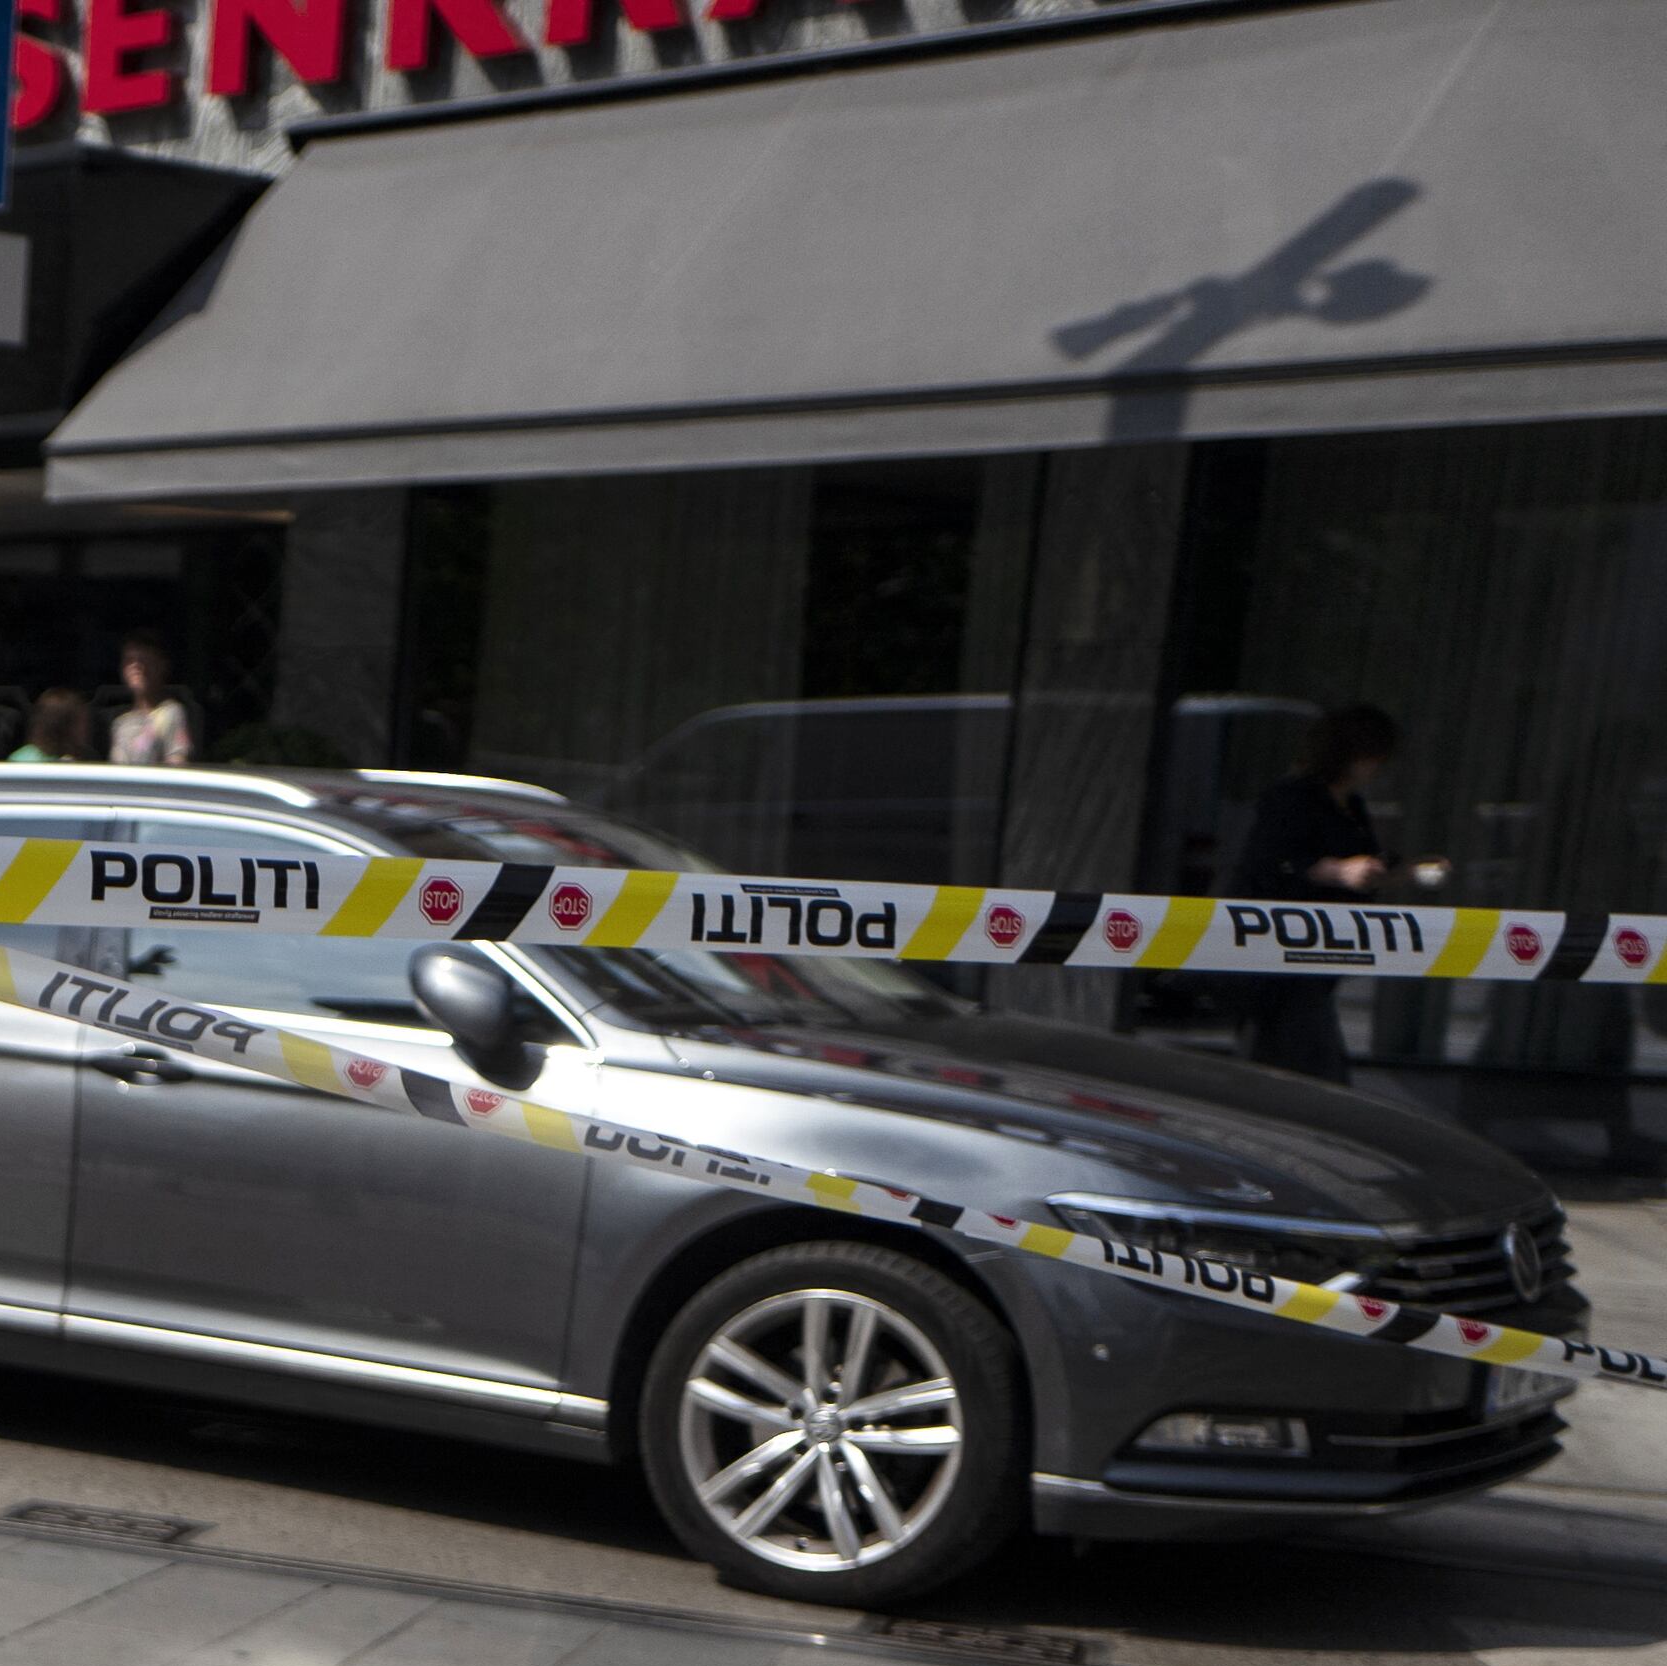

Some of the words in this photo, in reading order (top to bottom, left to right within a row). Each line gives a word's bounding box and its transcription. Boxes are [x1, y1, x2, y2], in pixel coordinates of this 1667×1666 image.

[90, 849, 321, 911] POLITI
[423, 889, 458, 910] STOP
[553, 895, 589, 916] STOP
[690, 892, 898, 950] POLITI
[988, 915, 1021, 934] STOP
[1107, 918, 1139, 939] STOP
[1226, 903, 1424, 953] POLITI
